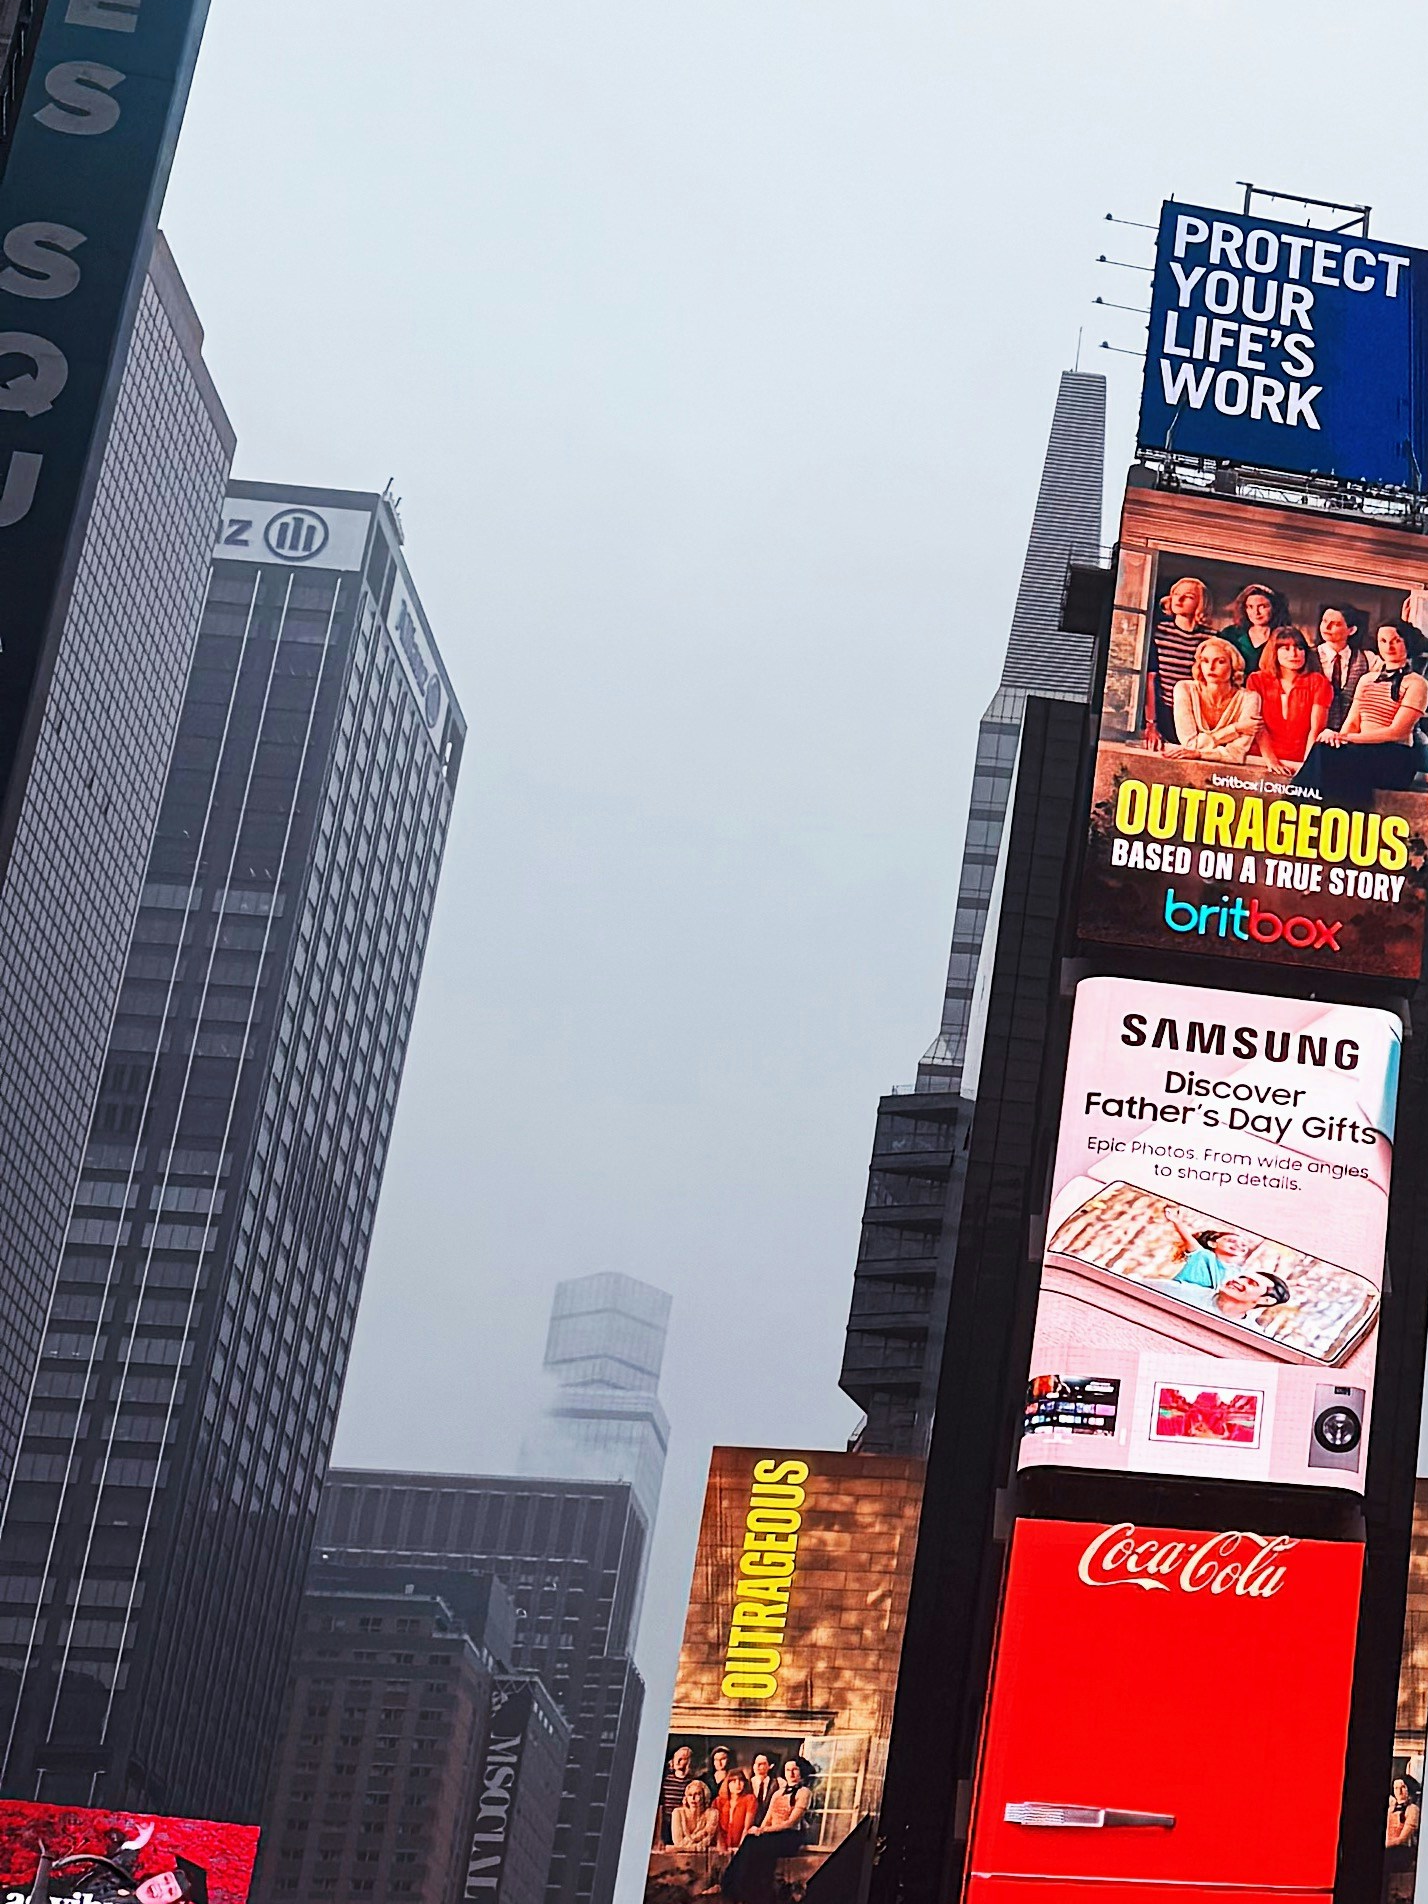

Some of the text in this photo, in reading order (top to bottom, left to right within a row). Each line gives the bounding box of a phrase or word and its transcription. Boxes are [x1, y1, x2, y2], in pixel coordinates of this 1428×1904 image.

[1172, 214, 1410, 299] PROTECT
[1169, 262, 1315, 332] YOUR
[1161, 310, 1316, 379] LIFE'S
[1159, 358, 1322, 431] WORK
[1116, 778, 1410, 870] OUTRAGEOUS
[1111, 839, 1406, 903] BASED ON A TRUE STORY
[1164, 888, 1342, 952] britbox
[1121, 1013, 1360, 1071] SAMSUNG
[1085, 1092, 1377, 1146] Father's Day Gifts
[1164, 1071, 1307, 1108] Discover
[1087, 1137, 1370, 1181] Epic Photos. From wide angles
[1154, 1164, 1302, 1192] to sharp details.
[722, 1458, 811, 1700] OUTRAGEOUS
[1078, 1523, 1296, 1598] Coca-Cola
